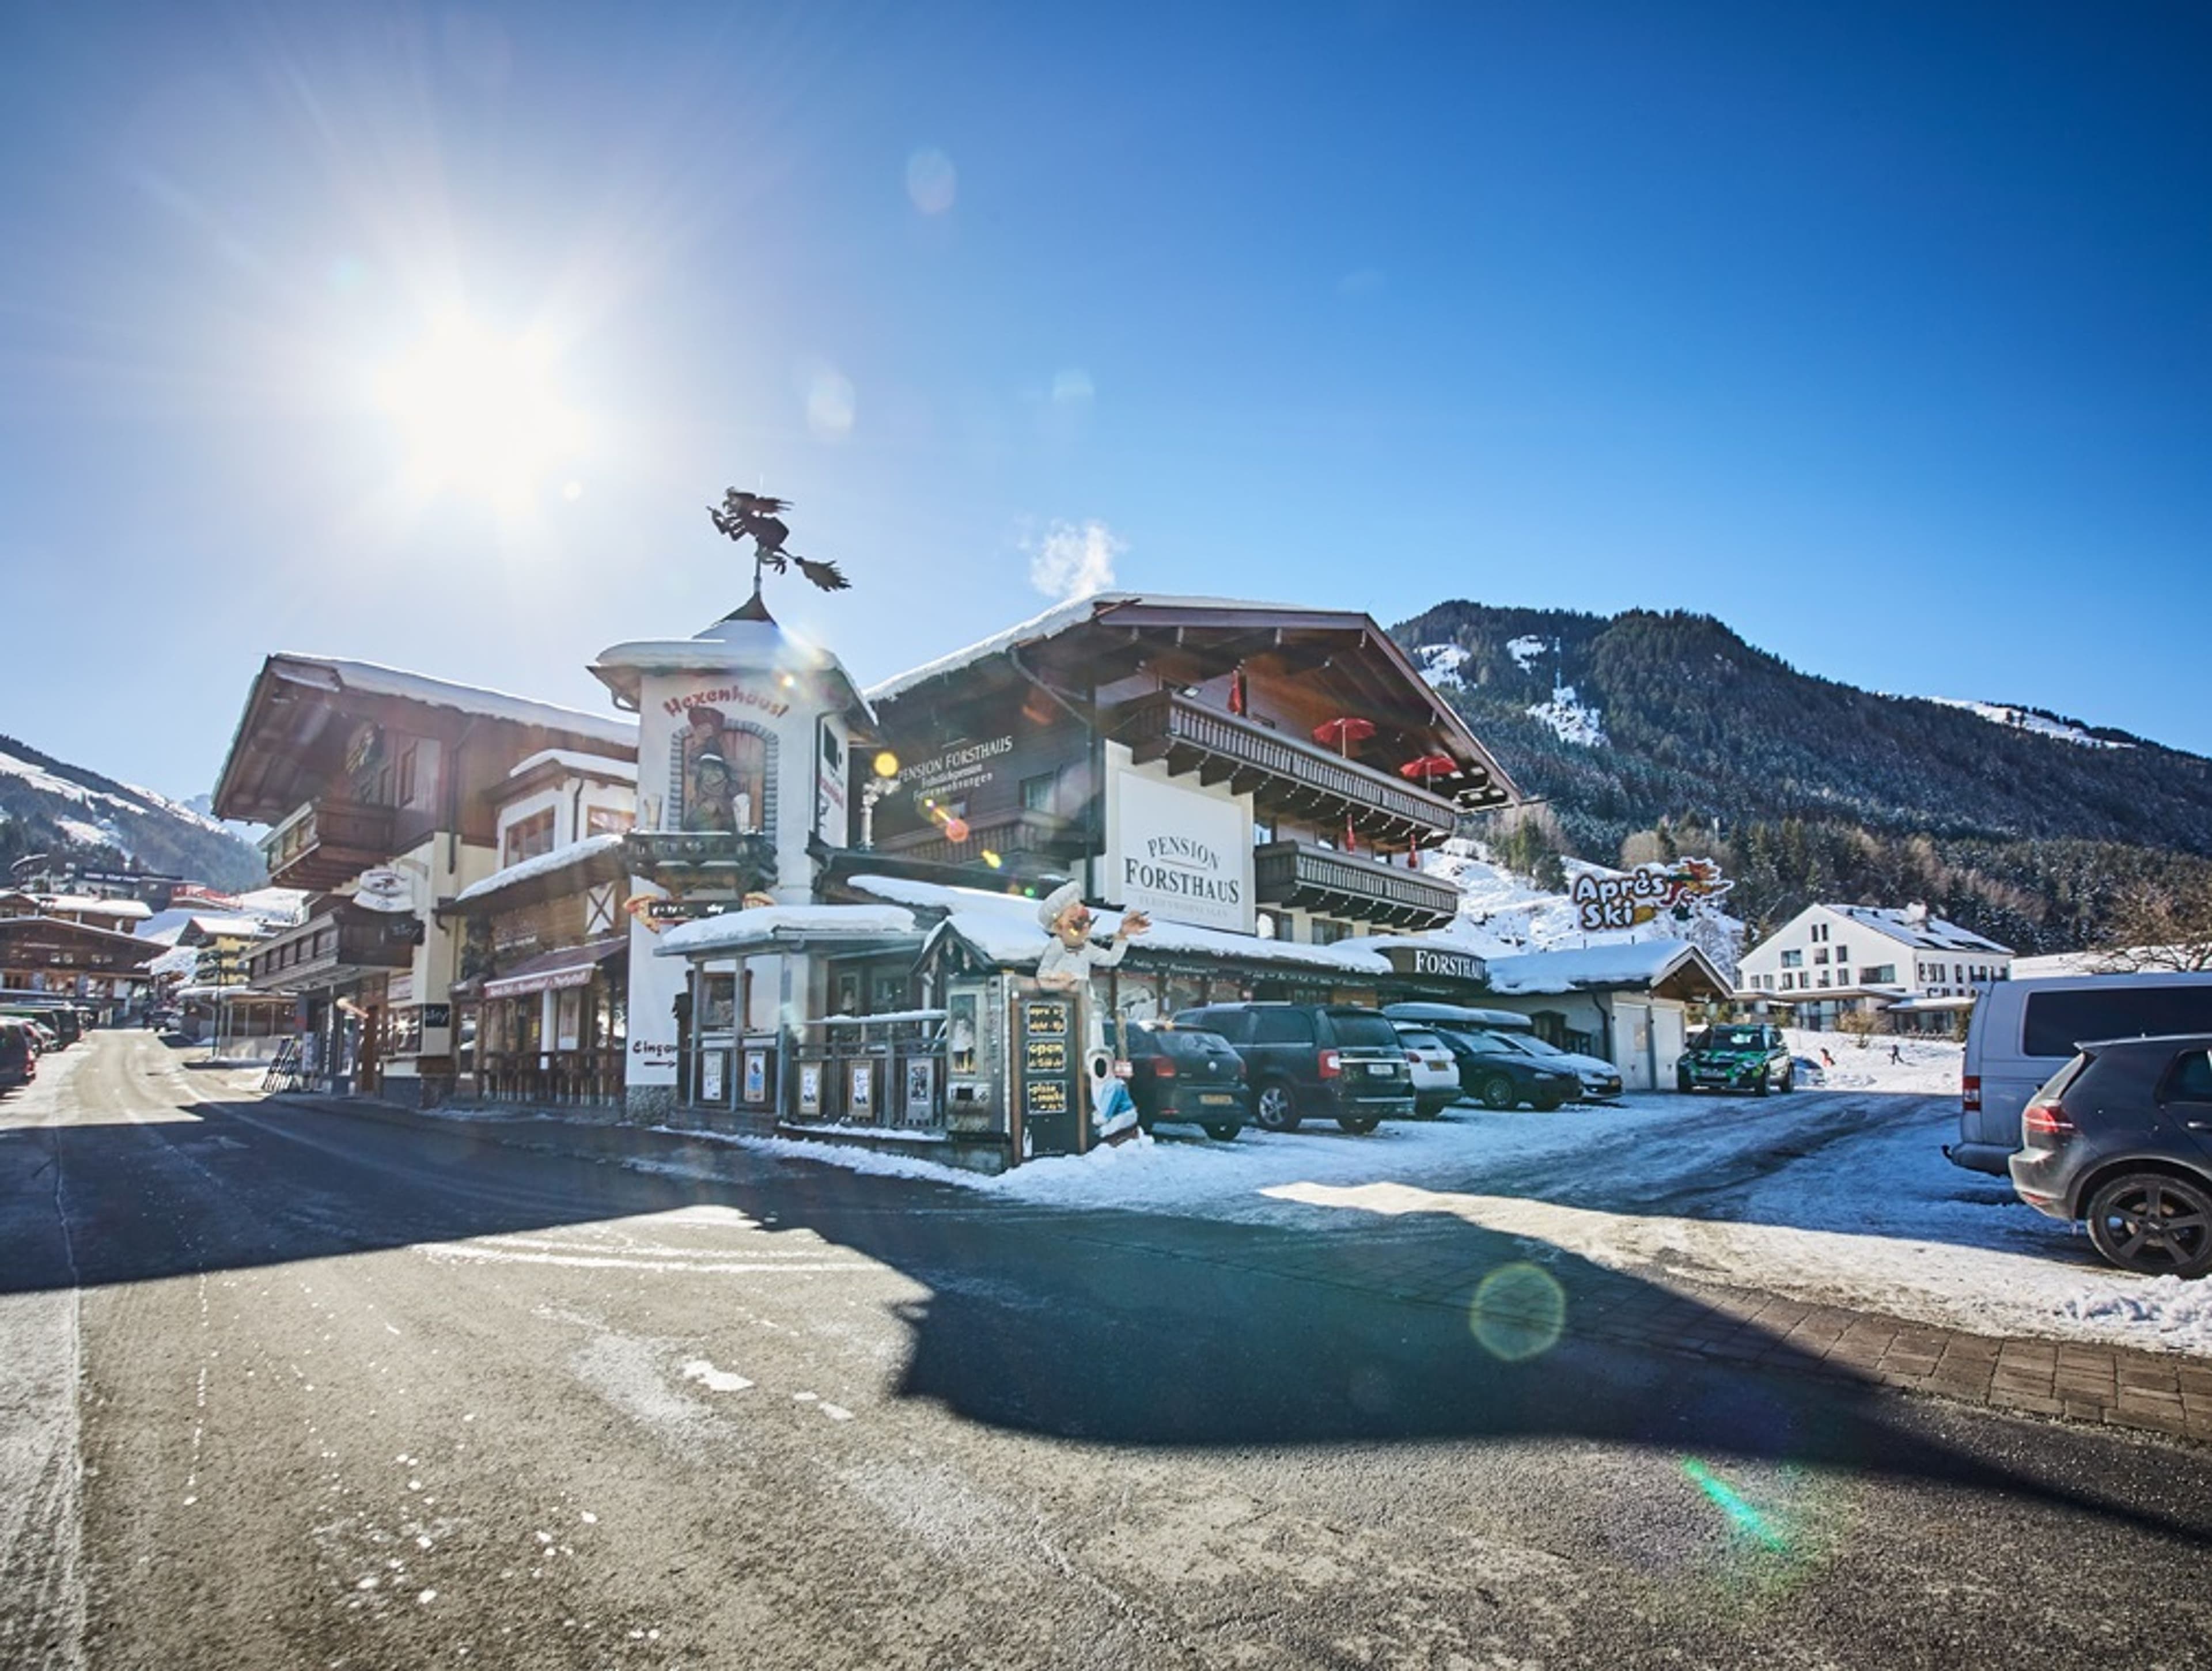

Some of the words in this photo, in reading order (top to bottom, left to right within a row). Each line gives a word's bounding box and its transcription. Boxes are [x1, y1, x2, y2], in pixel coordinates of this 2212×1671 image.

[946, 734, 1013, 770] FORSTHAUS
[1147, 836, 1221, 870] PENSION
[1124, 857, 1239, 905] FORSTHAUS
[1575, 869, 1666, 904] Après
[1583, 899, 1634, 929] Ski
[1415, 950, 1484, 980] FORSTHAU
